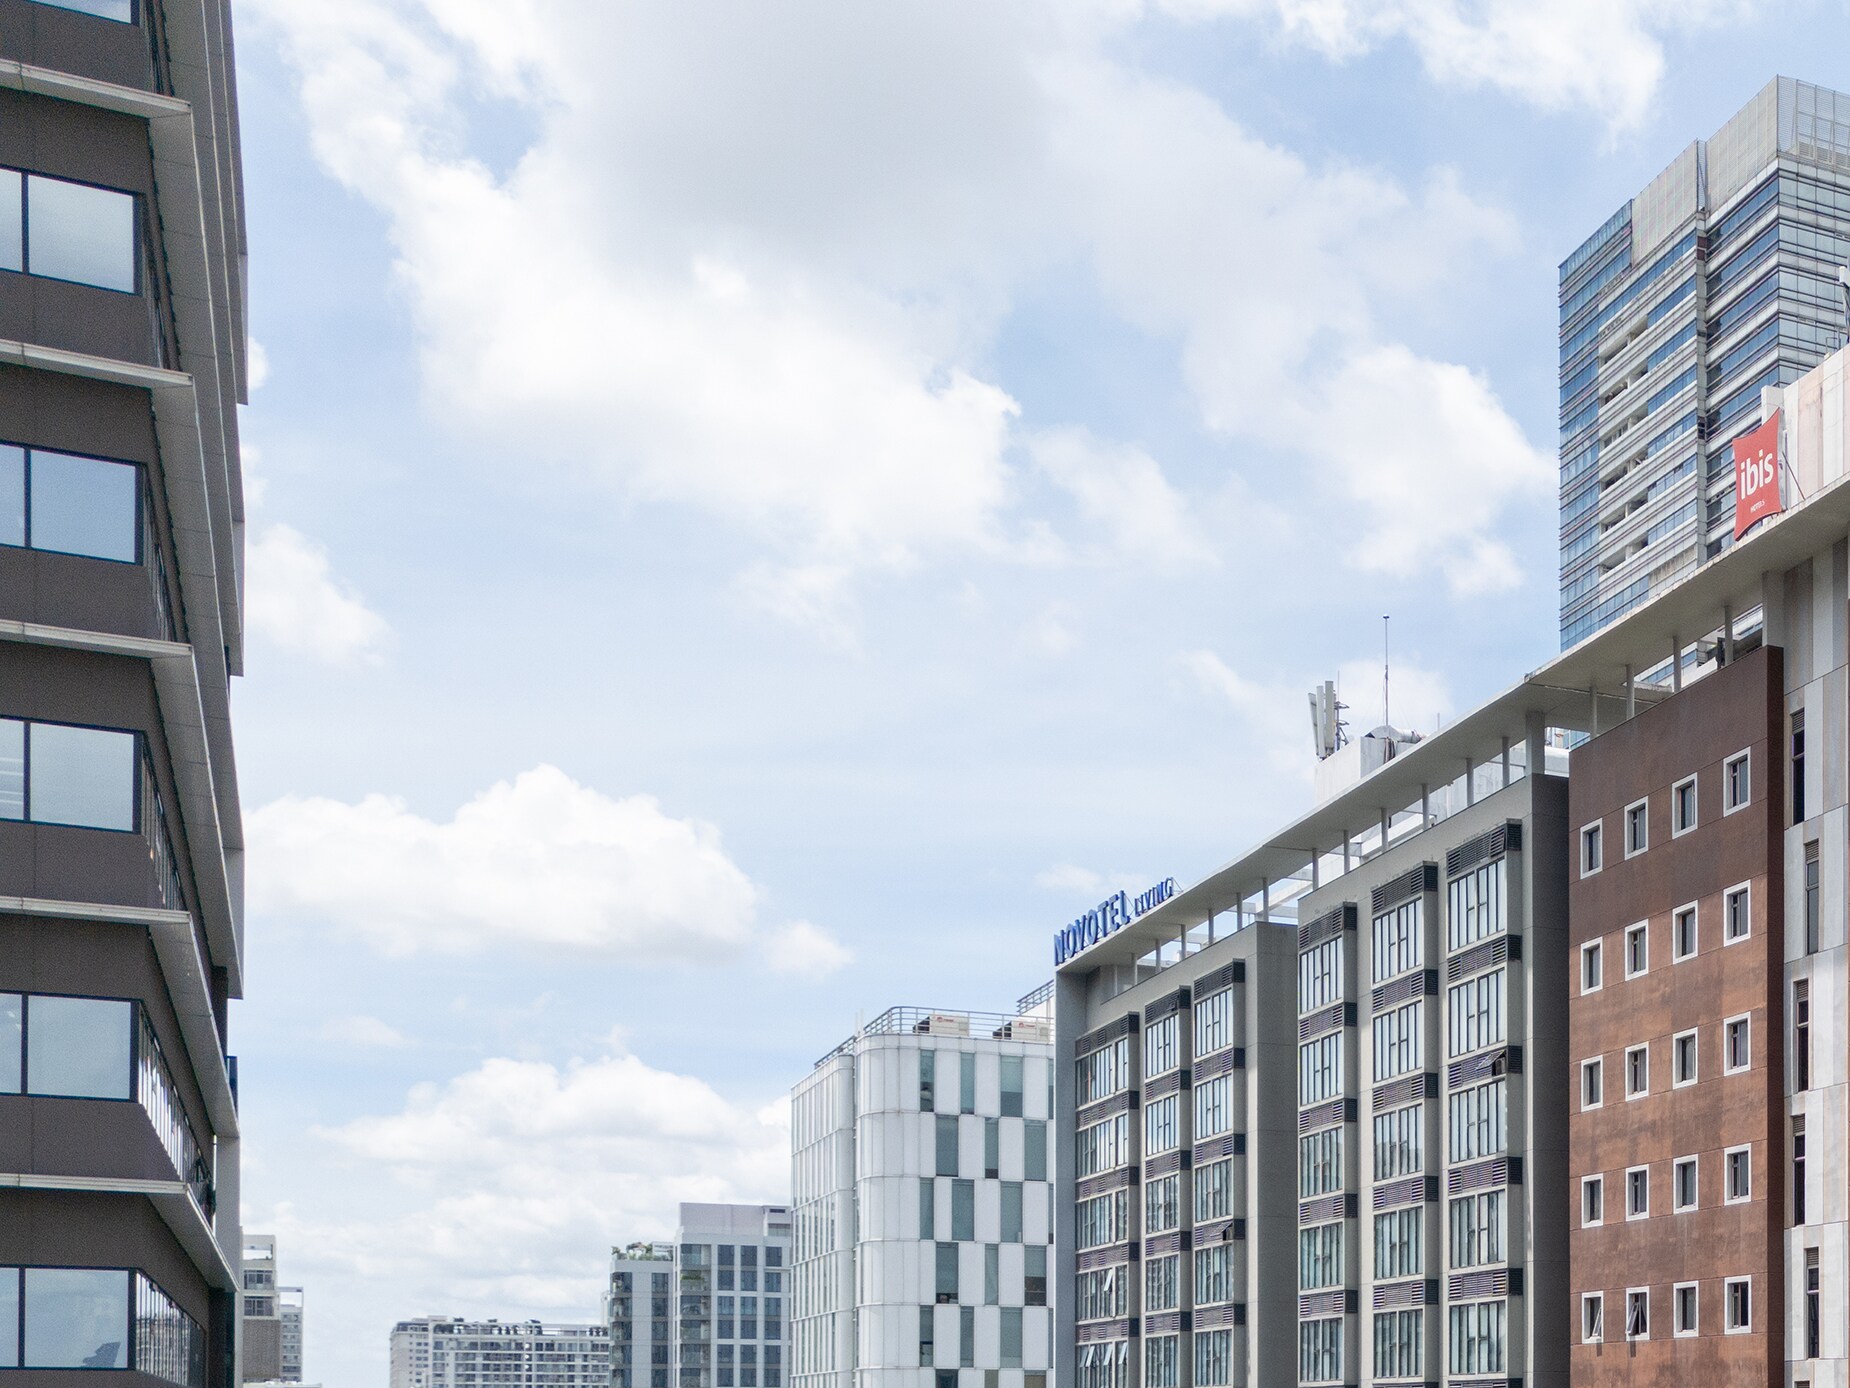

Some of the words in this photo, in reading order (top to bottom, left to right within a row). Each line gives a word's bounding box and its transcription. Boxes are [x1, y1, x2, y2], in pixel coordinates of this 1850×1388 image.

[1741, 449, 1774, 500] ibis
[1053, 890, 1131, 967] NOVOTEL
[1134, 877, 1174, 917] LIVING
